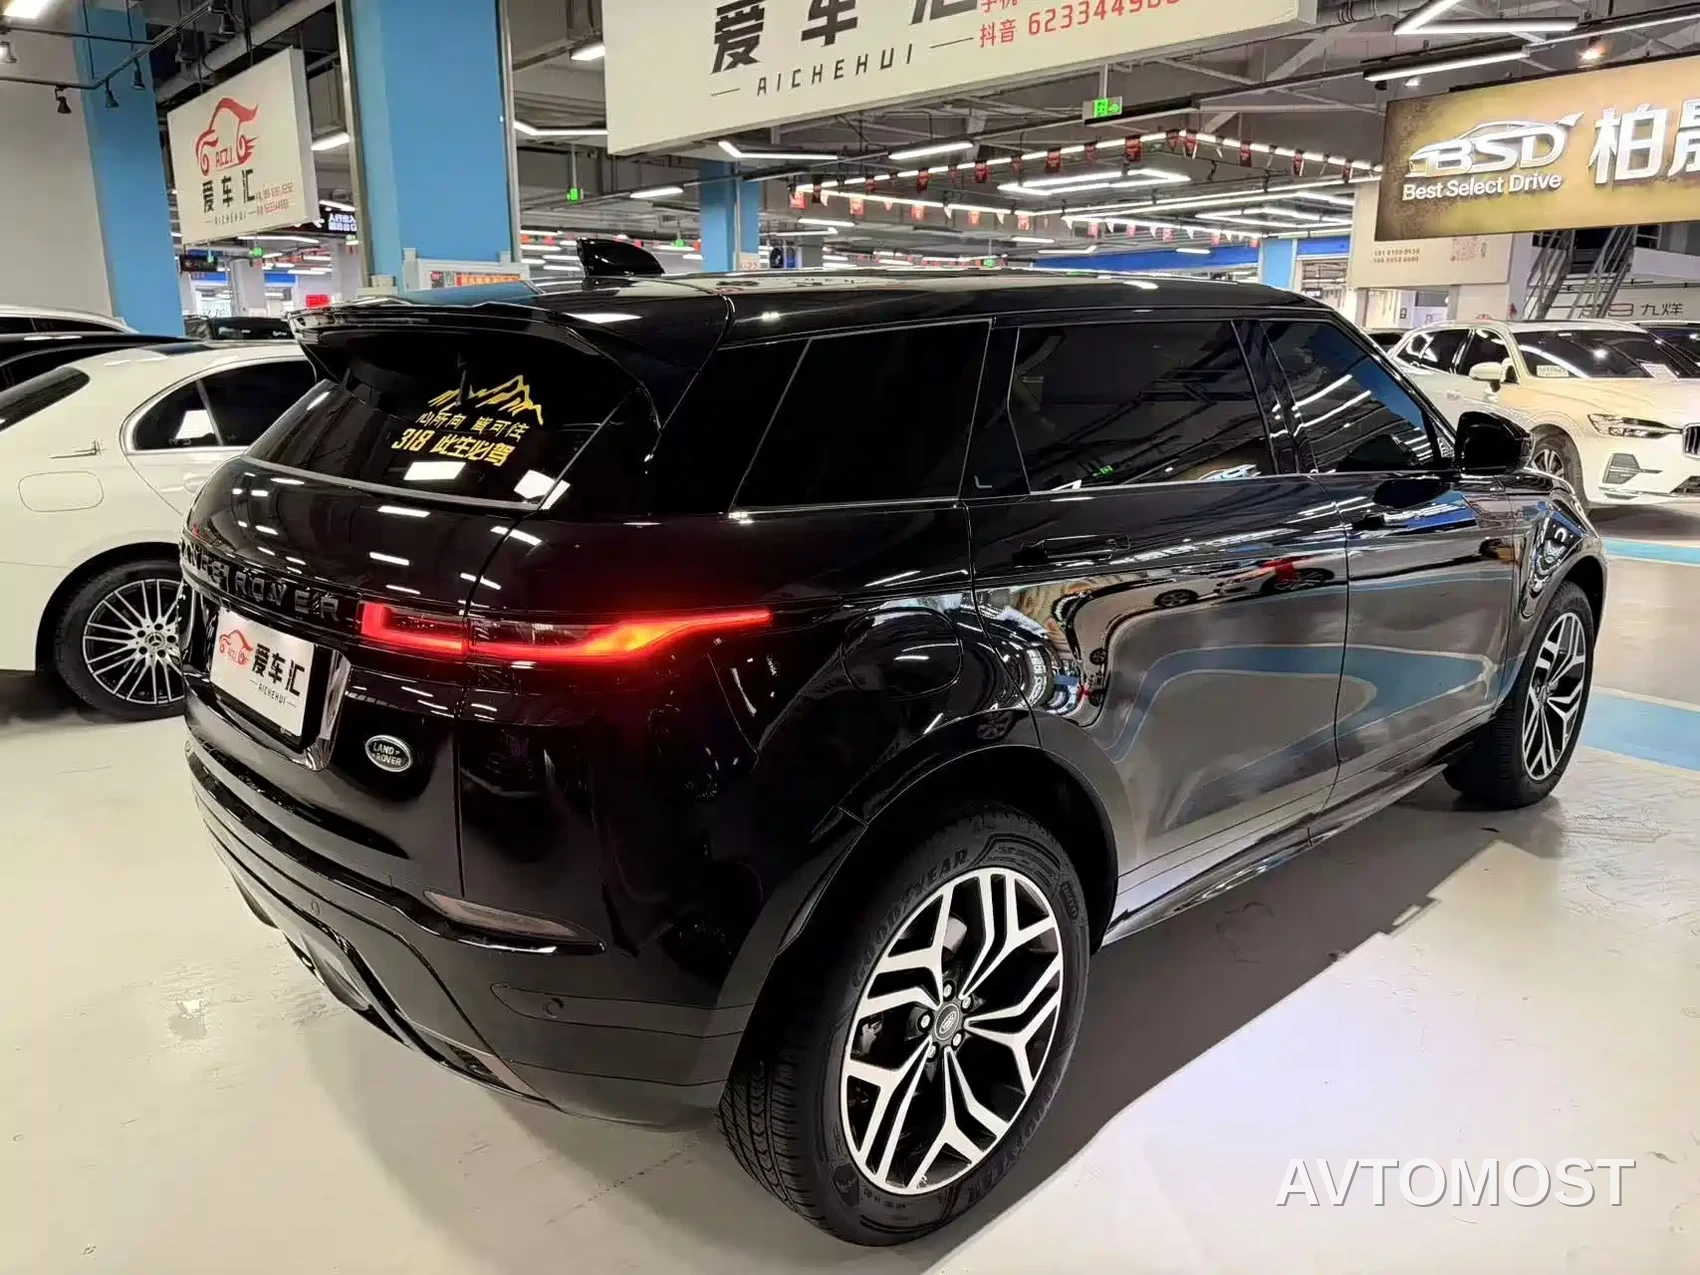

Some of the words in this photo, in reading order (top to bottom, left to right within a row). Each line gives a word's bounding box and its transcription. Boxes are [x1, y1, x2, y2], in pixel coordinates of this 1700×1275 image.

[979, 18, 1016, 48] 抖音
[756, 43, 913, 97] AICHEHUI
[1412, 124, 1570, 177] BSD
[202, 168, 256, 213] 爱车汇
[1402, 184, 1443, 201] Best
[1446, 177, 1505, 197] Select
[1508, 170, 1563, 192] Drive
[415, 411, 467, 430] 心所向
[391, 428, 436, 451] 318
[429, 433, 515, 467] 此生必驾
[252, 643, 305, 697] 爱车汇
[373, 742, 395, 756] LAND
[376, 752, 402, 766] ROVER
